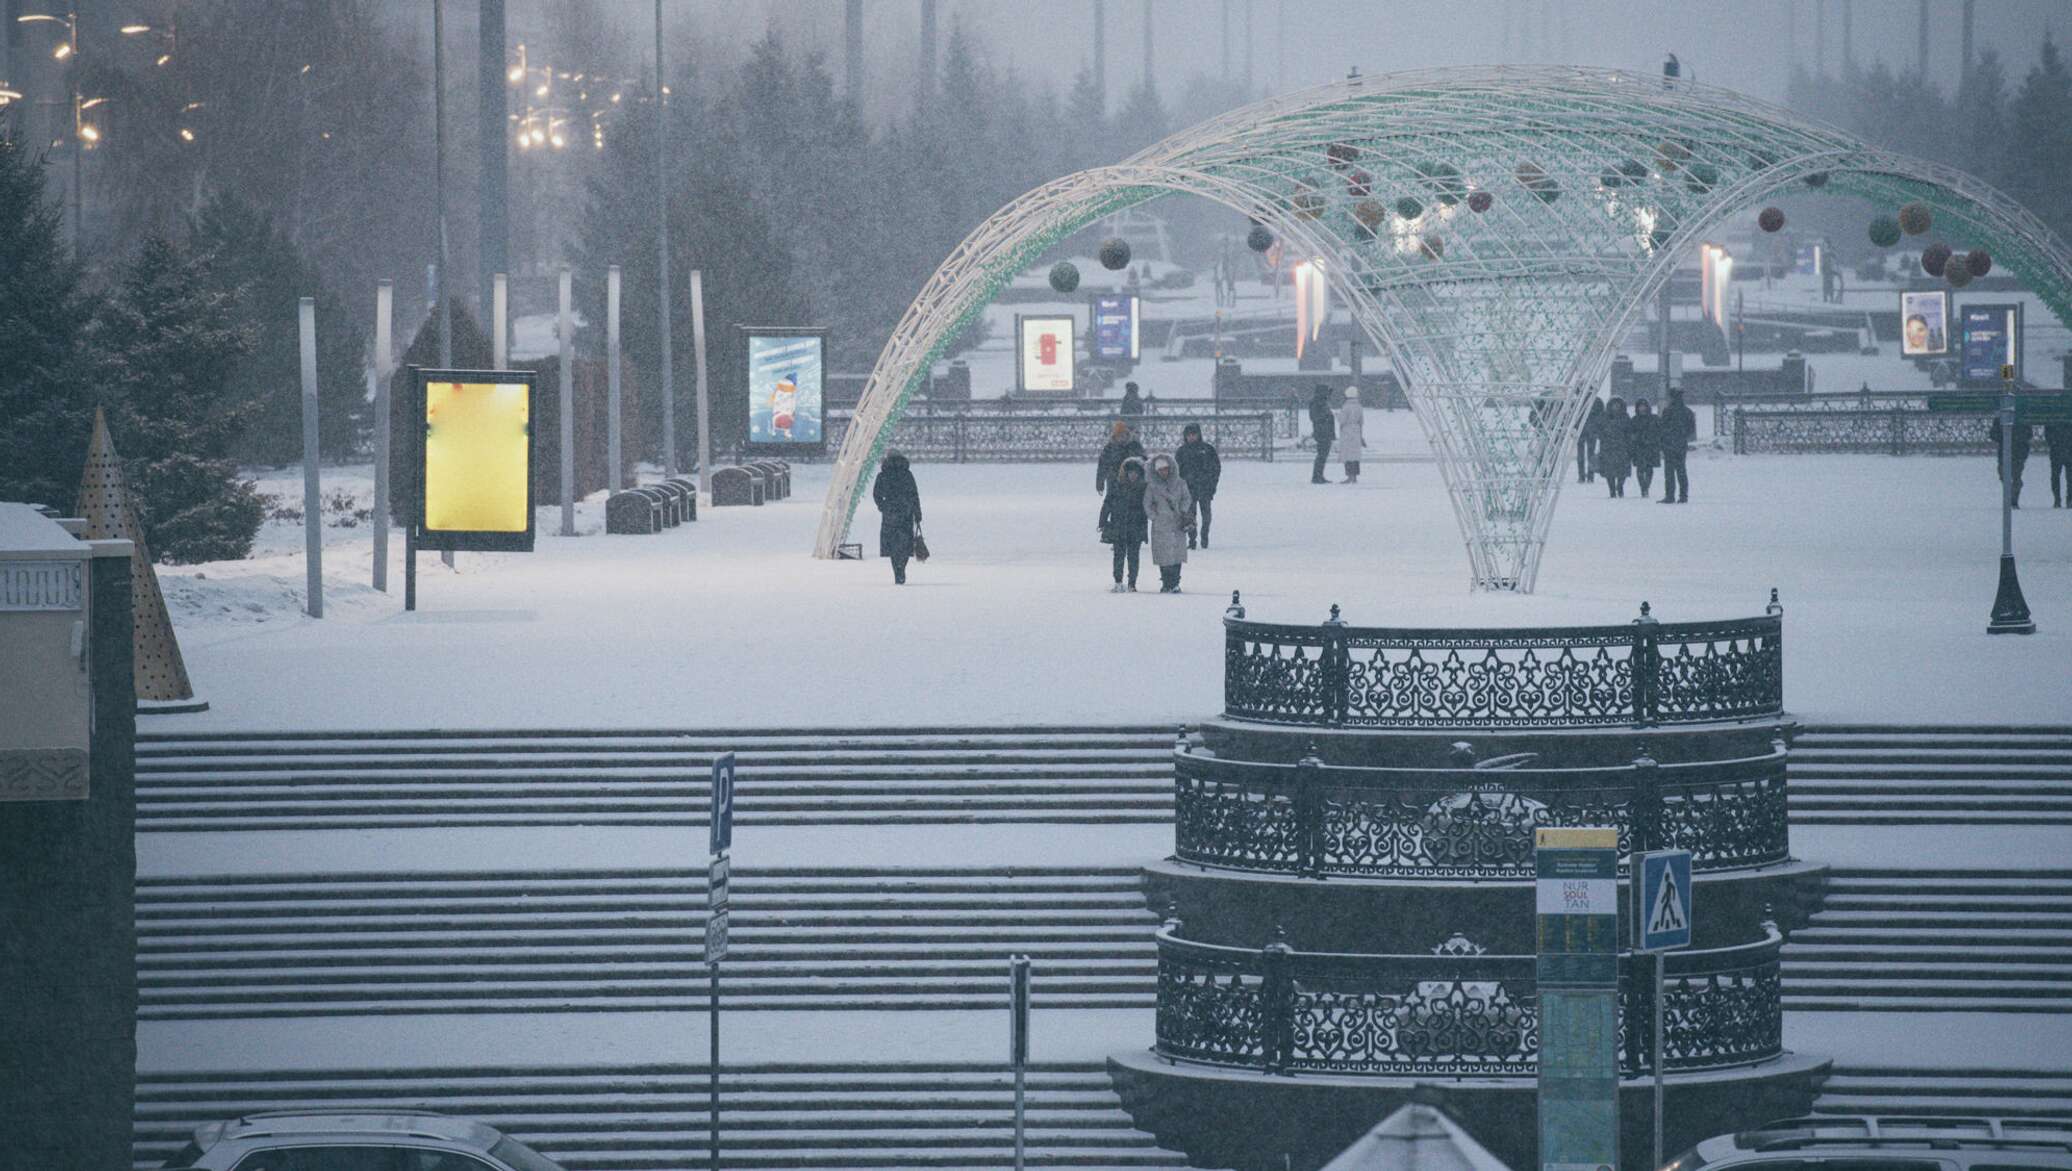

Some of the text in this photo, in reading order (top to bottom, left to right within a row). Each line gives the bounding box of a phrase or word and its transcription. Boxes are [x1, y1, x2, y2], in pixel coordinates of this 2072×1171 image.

[717, 767, 729, 841] P
[1563, 881, 1589, 891] NUR
[1564, 891, 1588, 899] SOUL
[1565, 900, 1590, 909] TAN
